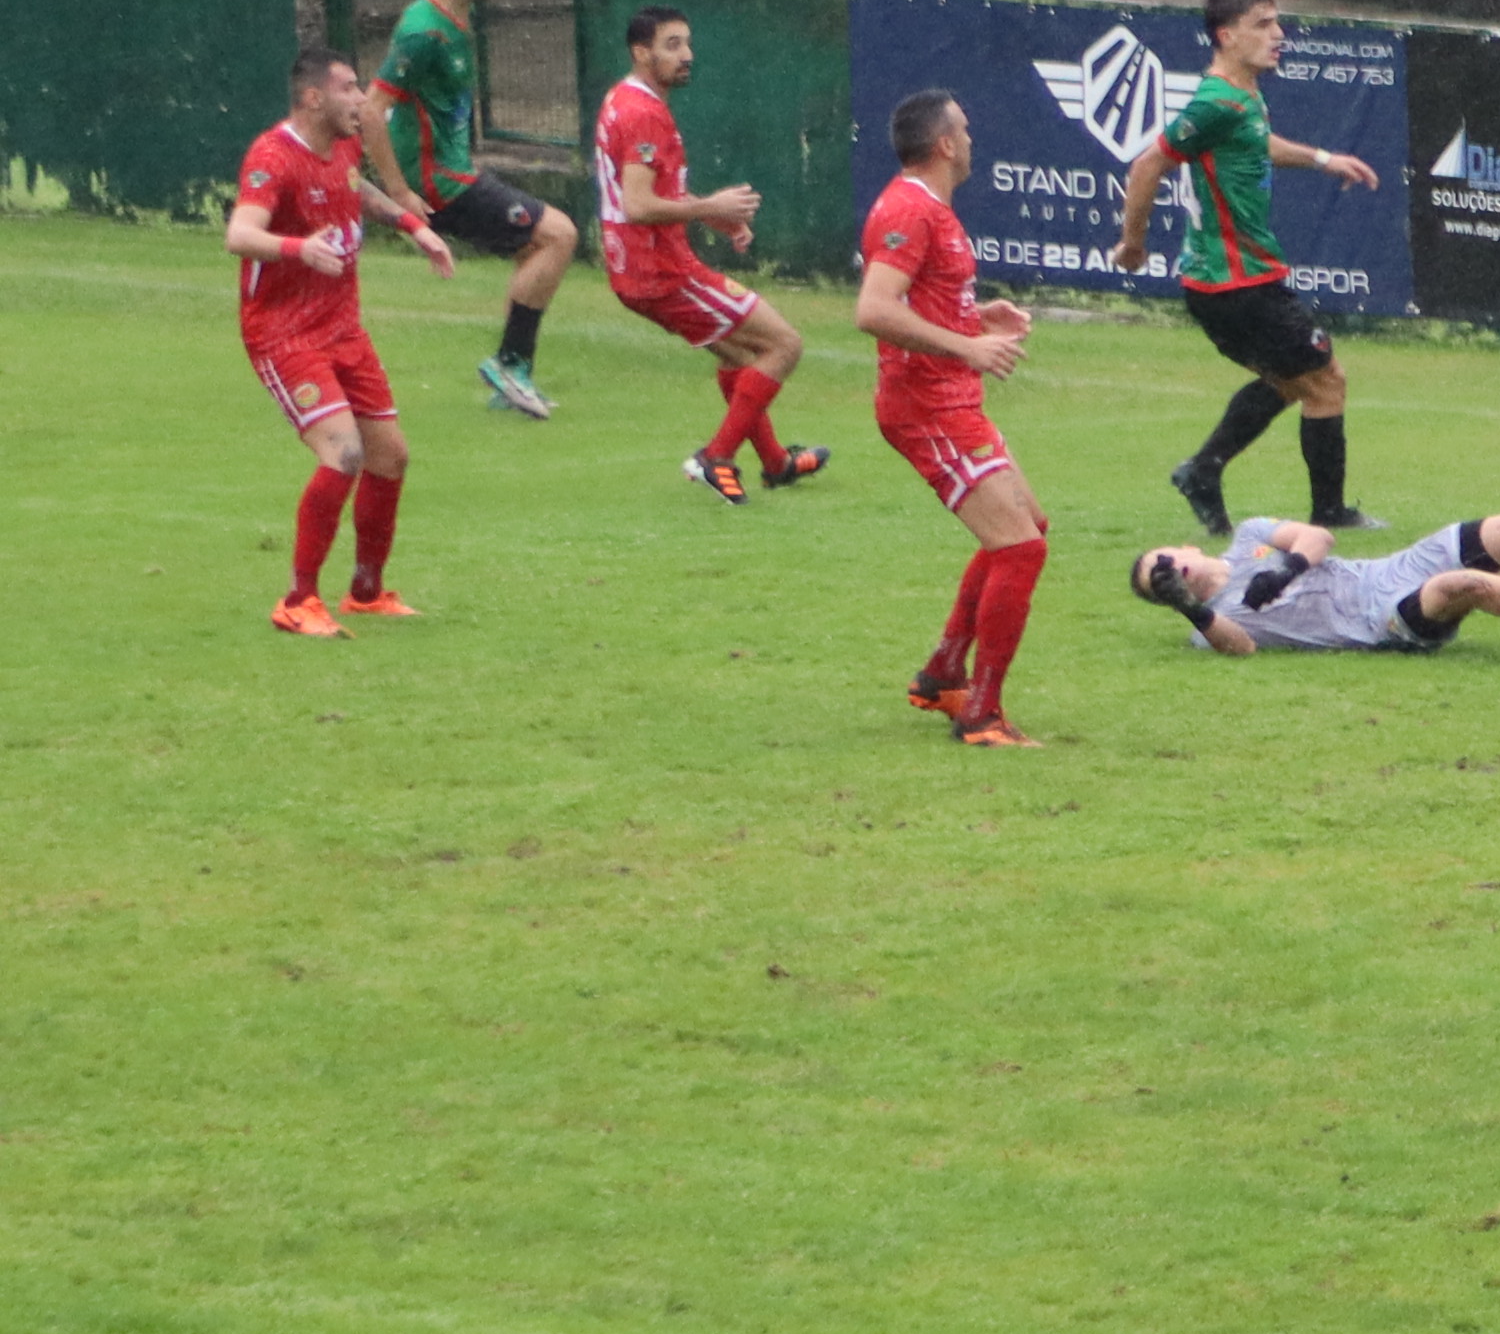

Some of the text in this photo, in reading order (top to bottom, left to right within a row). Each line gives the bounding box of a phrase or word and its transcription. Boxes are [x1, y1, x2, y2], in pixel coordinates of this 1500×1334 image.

[992, 160, 1097, 200] STAND
[1004, 237, 1041, 265] DE
[1042, 242, 1081, 270] 25
[1084, 246, 1168, 278] ANS
